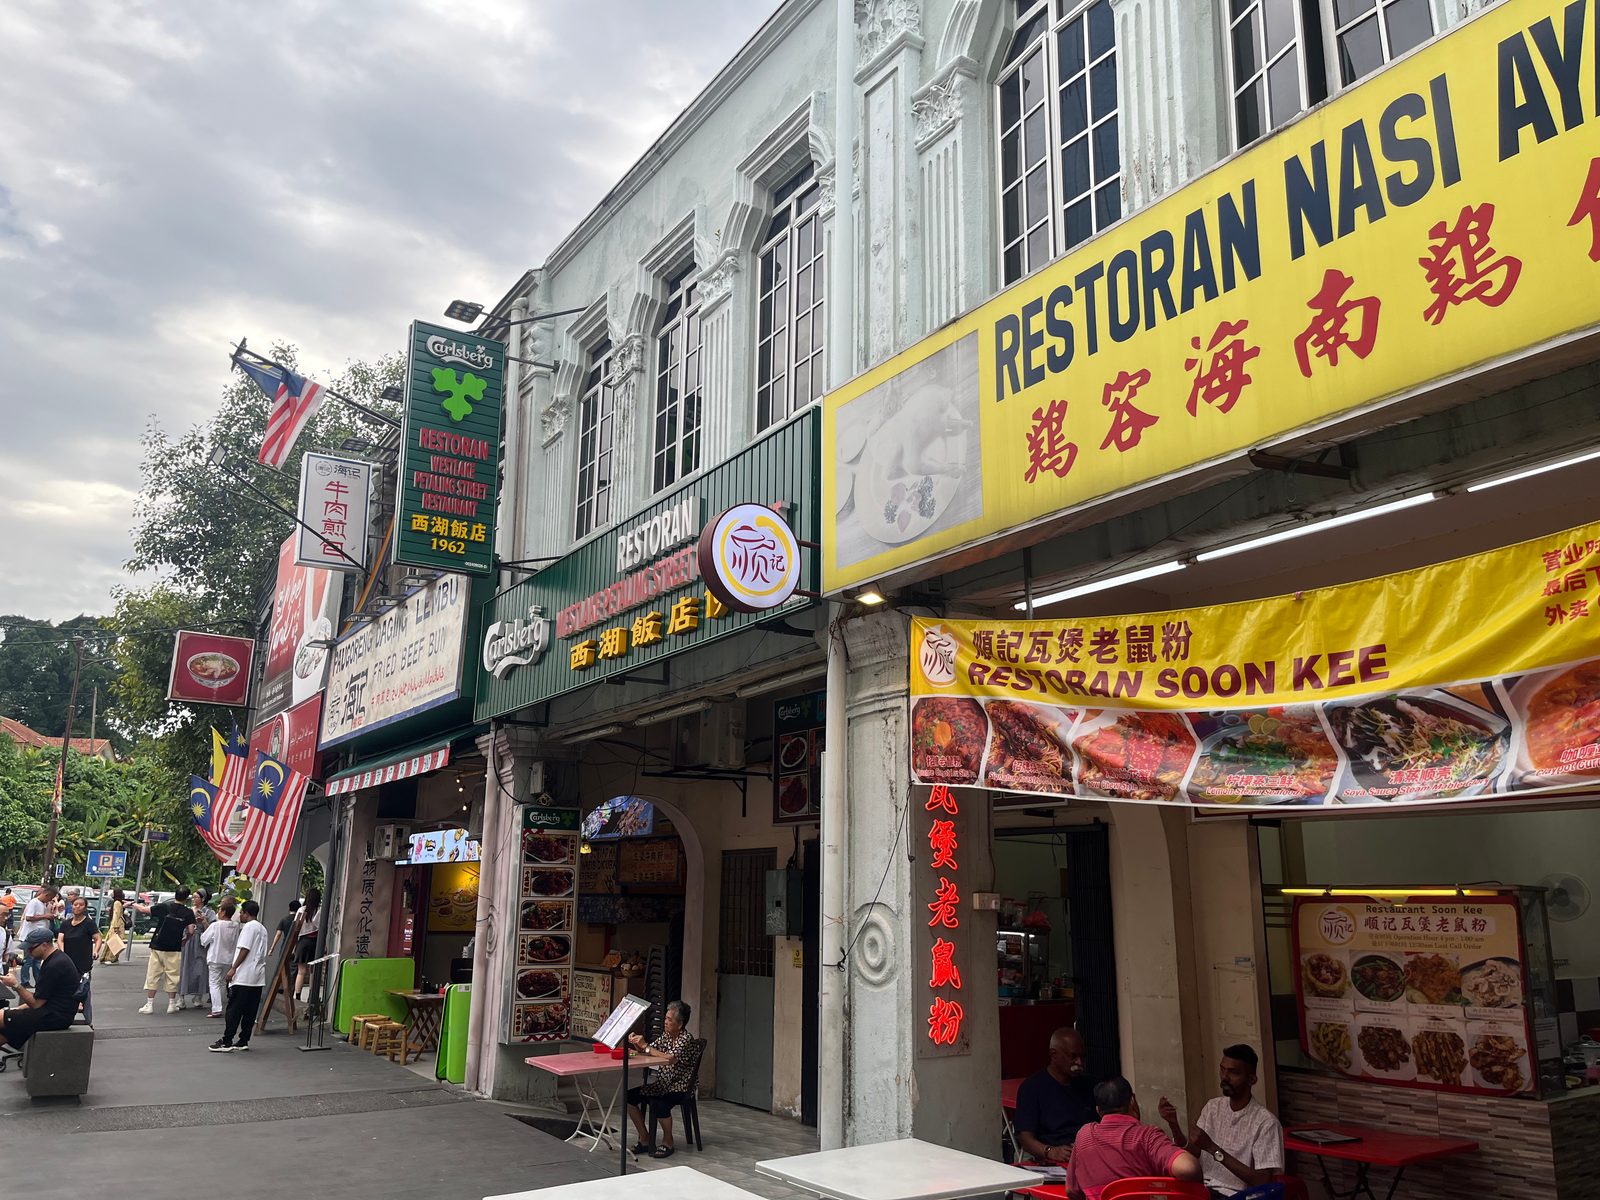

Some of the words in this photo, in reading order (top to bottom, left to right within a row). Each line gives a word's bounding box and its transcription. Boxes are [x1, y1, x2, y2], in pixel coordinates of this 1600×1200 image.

[995, 179, 1262, 402] RESTORAN
[1284, 73, 1462, 261] NASI
[1498, 0, 1600, 162] AY
[427, 335, 493, 369] Carlsberg
[419, 426, 489, 461] RESTORAN
[430, 455, 477, 479] WESTLAKE
[413, 470, 456, 495] PETALING
[456, 479, 488, 500] STREET
[320, 480, 349, 562] 牛肉煎包
[422, 492, 478, 517] RESTAURANT
[411, 513, 487, 542] 西湖飯店
[617, 496, 697, 573] RESTORAN
[431, 538, 465, 554] 1962
[415, 576, 459, 625] LEMBU
[556, 592, 601, 640] WESTLAKE
[600, 567, 650, 624] PETALING
[652, 545, 697, 600] STREET
[484, 608, 551, 679] Carlsberg
[570, 596, 700, 671] 西湖飯店
[373, 653, 397, 680] FRIED
[400, 636, 425, 671] BEEF
[428, 625, 447, 658] BUN
[968, 662, 1143, 699] RESTORAN
[1154, 660, 1276, 700] SOON
[1292, 644, 1391, 692] KEE
[1368, 786, 1398, 797] Sauce
[529, 811, 561, 825] Carlsberg
[101, 856, 111, 866] P
[353, 860, 378, 958] 物质文化遗
[1366, 904, 1426, 914] Restaurant
[1431, 905, 1457, 914] Soon
[1463, 905, 1483, 914] Kee
